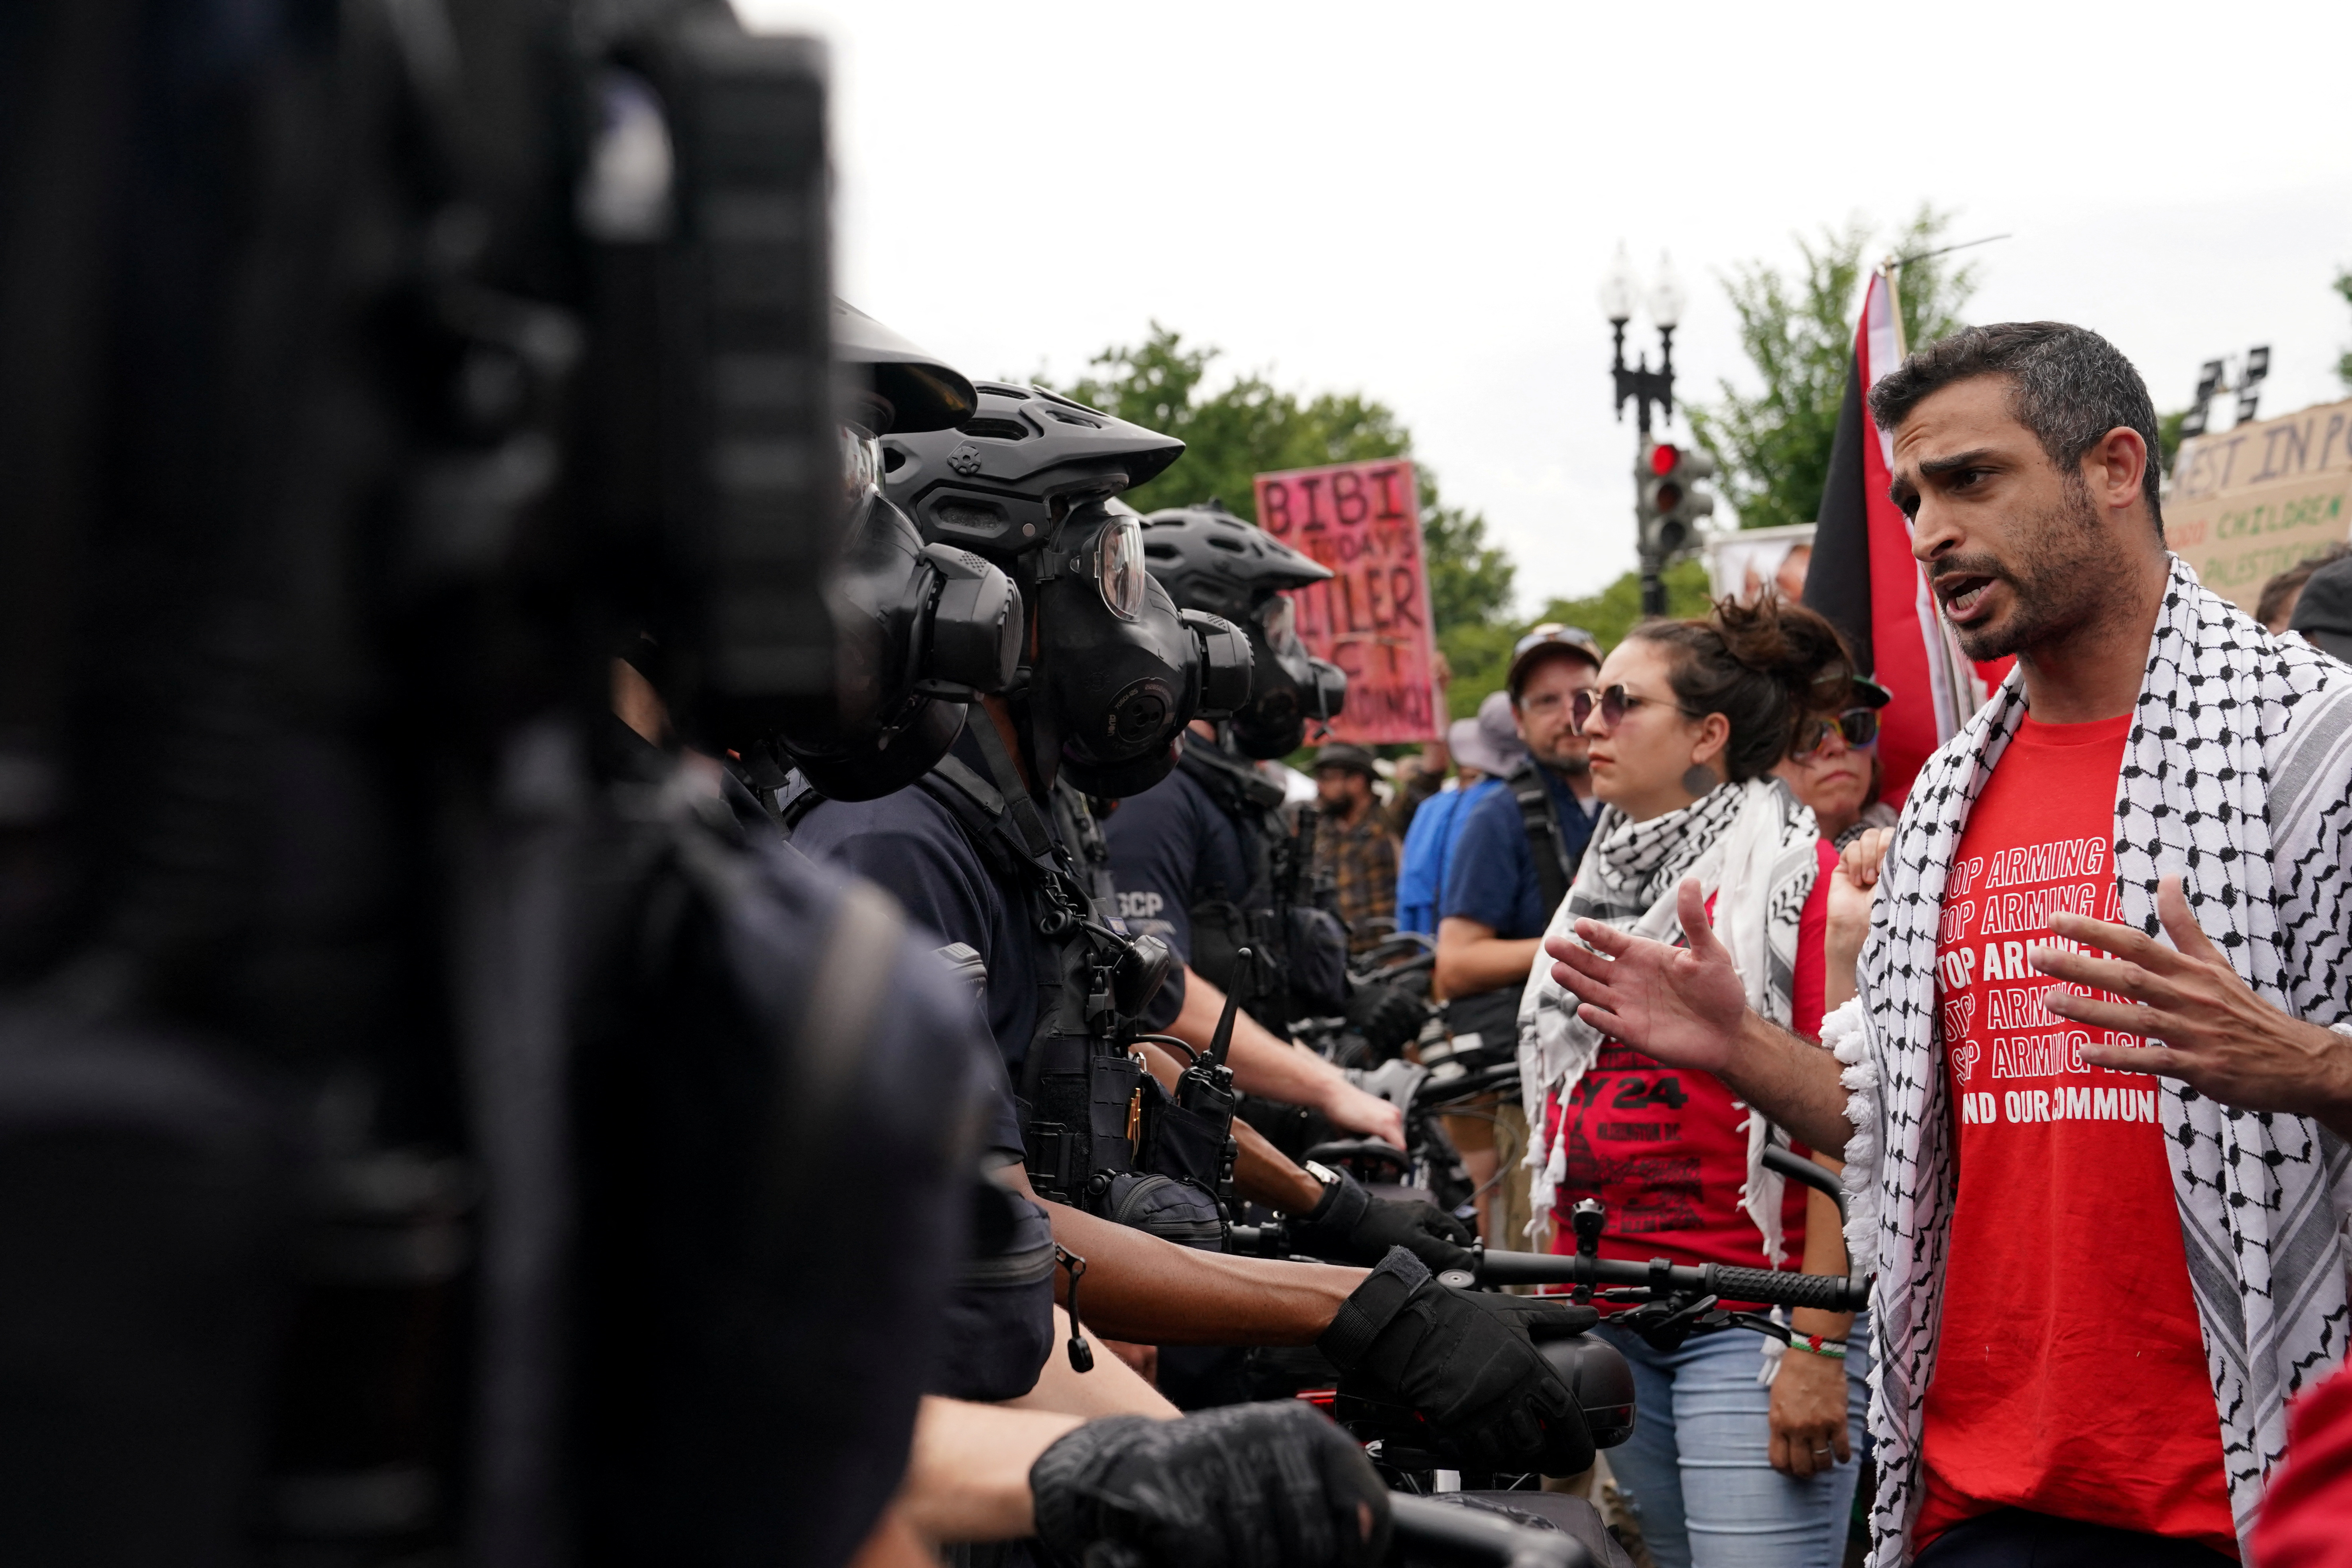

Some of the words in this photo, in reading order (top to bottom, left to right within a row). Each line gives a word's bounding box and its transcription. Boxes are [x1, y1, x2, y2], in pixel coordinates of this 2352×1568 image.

[2173, 433, 2248, 500] EST
[2250, 417, 2315, 485] IN
[2320, 414, 2352, 471] P
[1264, 467, 1406, 535] BIBI
[1942, 856, 1984, 903] TOP
[1985, 836, 2106, 889] ARMING
[1117, 891, 1164, 917] SCP
[1937, 900, 1975, 948] TOP
[1980, 882, 2096, 935] ARMING
[1936, 946, 1975, 994] TOP
[1612, 1076, 1689, 1110] 24
[1962, 1092, 1997, 1125] ND
[2004, 1090, 2051, 1124] OUR
[2052, 1086, 2162, 1124] COMMUN
